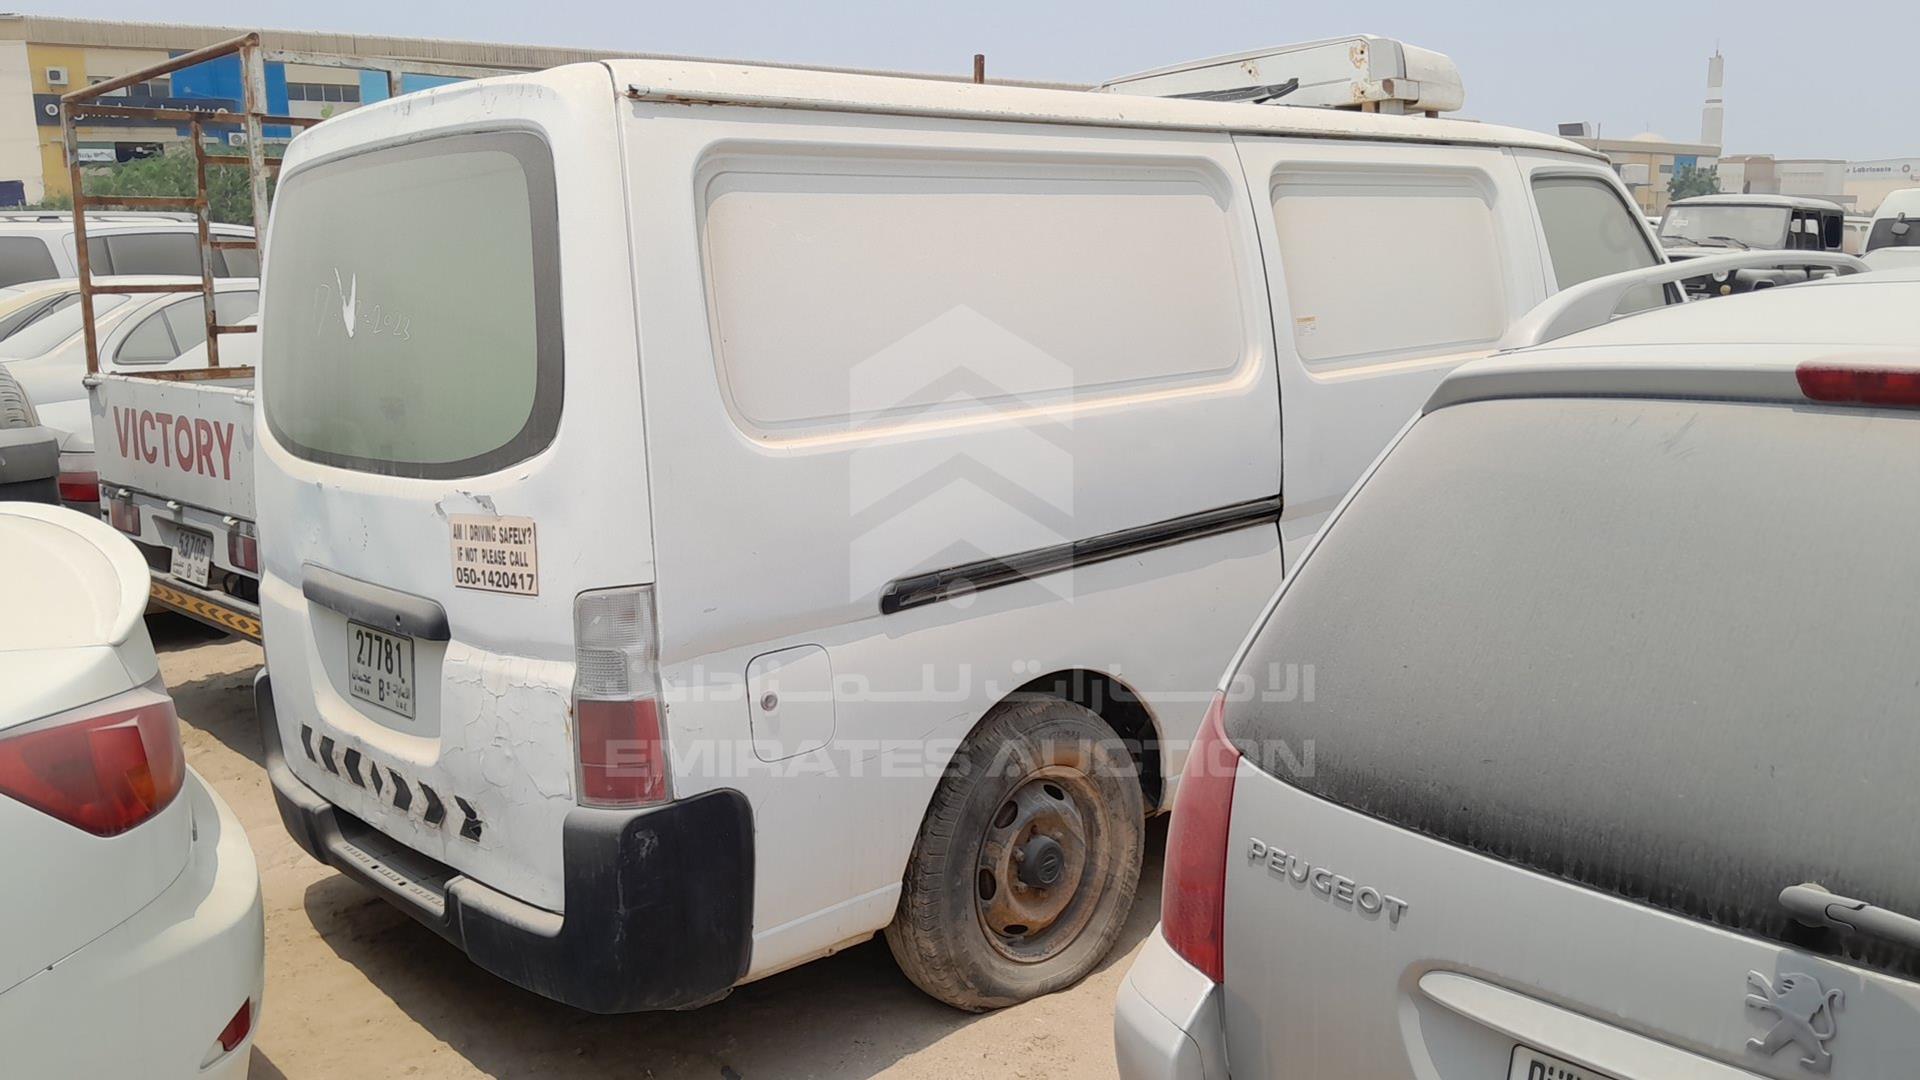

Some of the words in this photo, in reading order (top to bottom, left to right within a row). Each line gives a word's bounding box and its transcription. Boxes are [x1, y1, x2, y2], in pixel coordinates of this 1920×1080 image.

[113, 406, 234, 480] VICTORY
[178, 532, 207, 562] 53706
[453, 523, 462, 540] AM
[470, 525, 496, 542] DRIVING
[499, 527, 532, 545] SAFELY?
[457, 547, 463, 562] IF
[465, 548, 478, 563] NOT
[481, 548, 507, 566] PLEASE
[509, 551, 529, 568] CALL
[456, 567, 535, 591] 050-1420417
[356, 629, 403, 679] 27781
[1248, 837, 1409, 925] PEUGEOT
